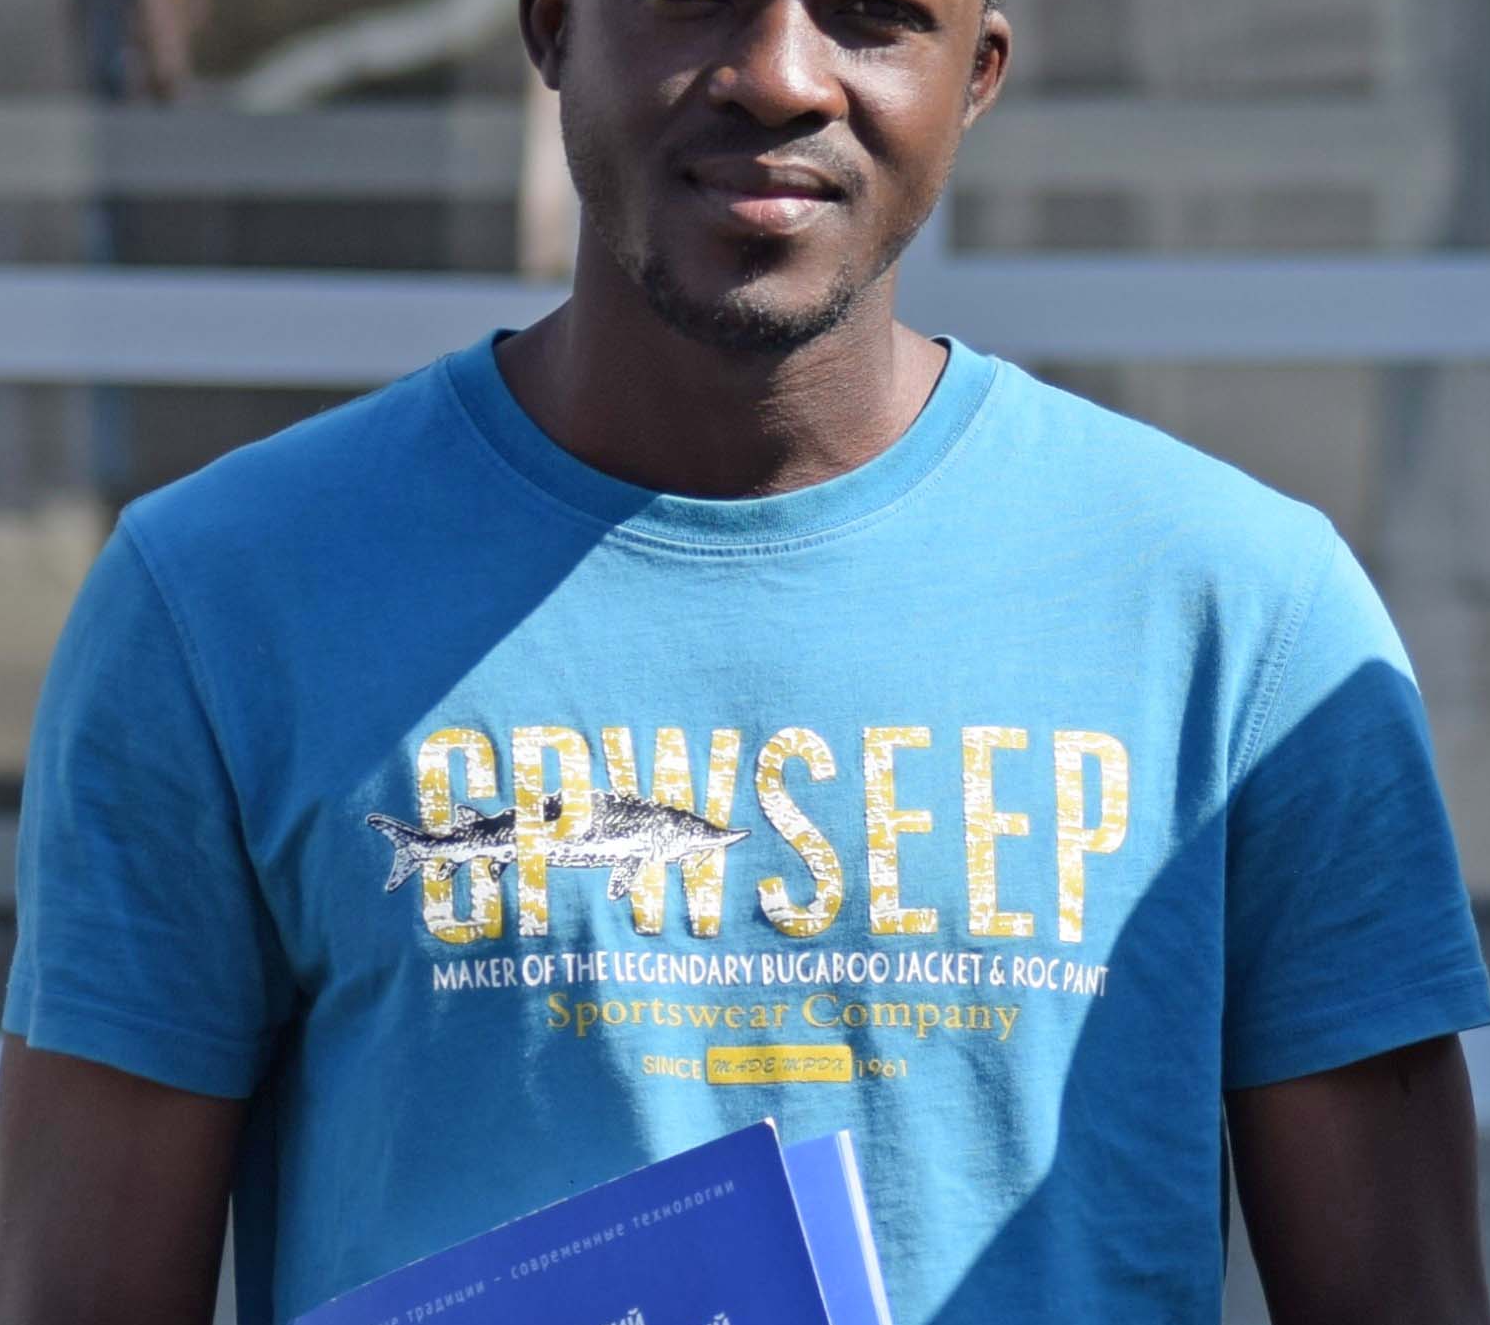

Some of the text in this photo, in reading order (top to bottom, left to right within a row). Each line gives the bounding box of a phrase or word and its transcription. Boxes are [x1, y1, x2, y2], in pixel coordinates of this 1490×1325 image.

[433, 951, 1109, 997] MAKER OF THE LEGENDARY BUGABOO JACKET & ROC PANT
[546, 992, 1021, 1040] Sportswear Company
[642, 1054, 703, 1080] SINCE
[406, 1280, 485, 1324] традиции
[511, 1222, 625, 1280] современные
[632, 1179, 735, 1229] технологии
